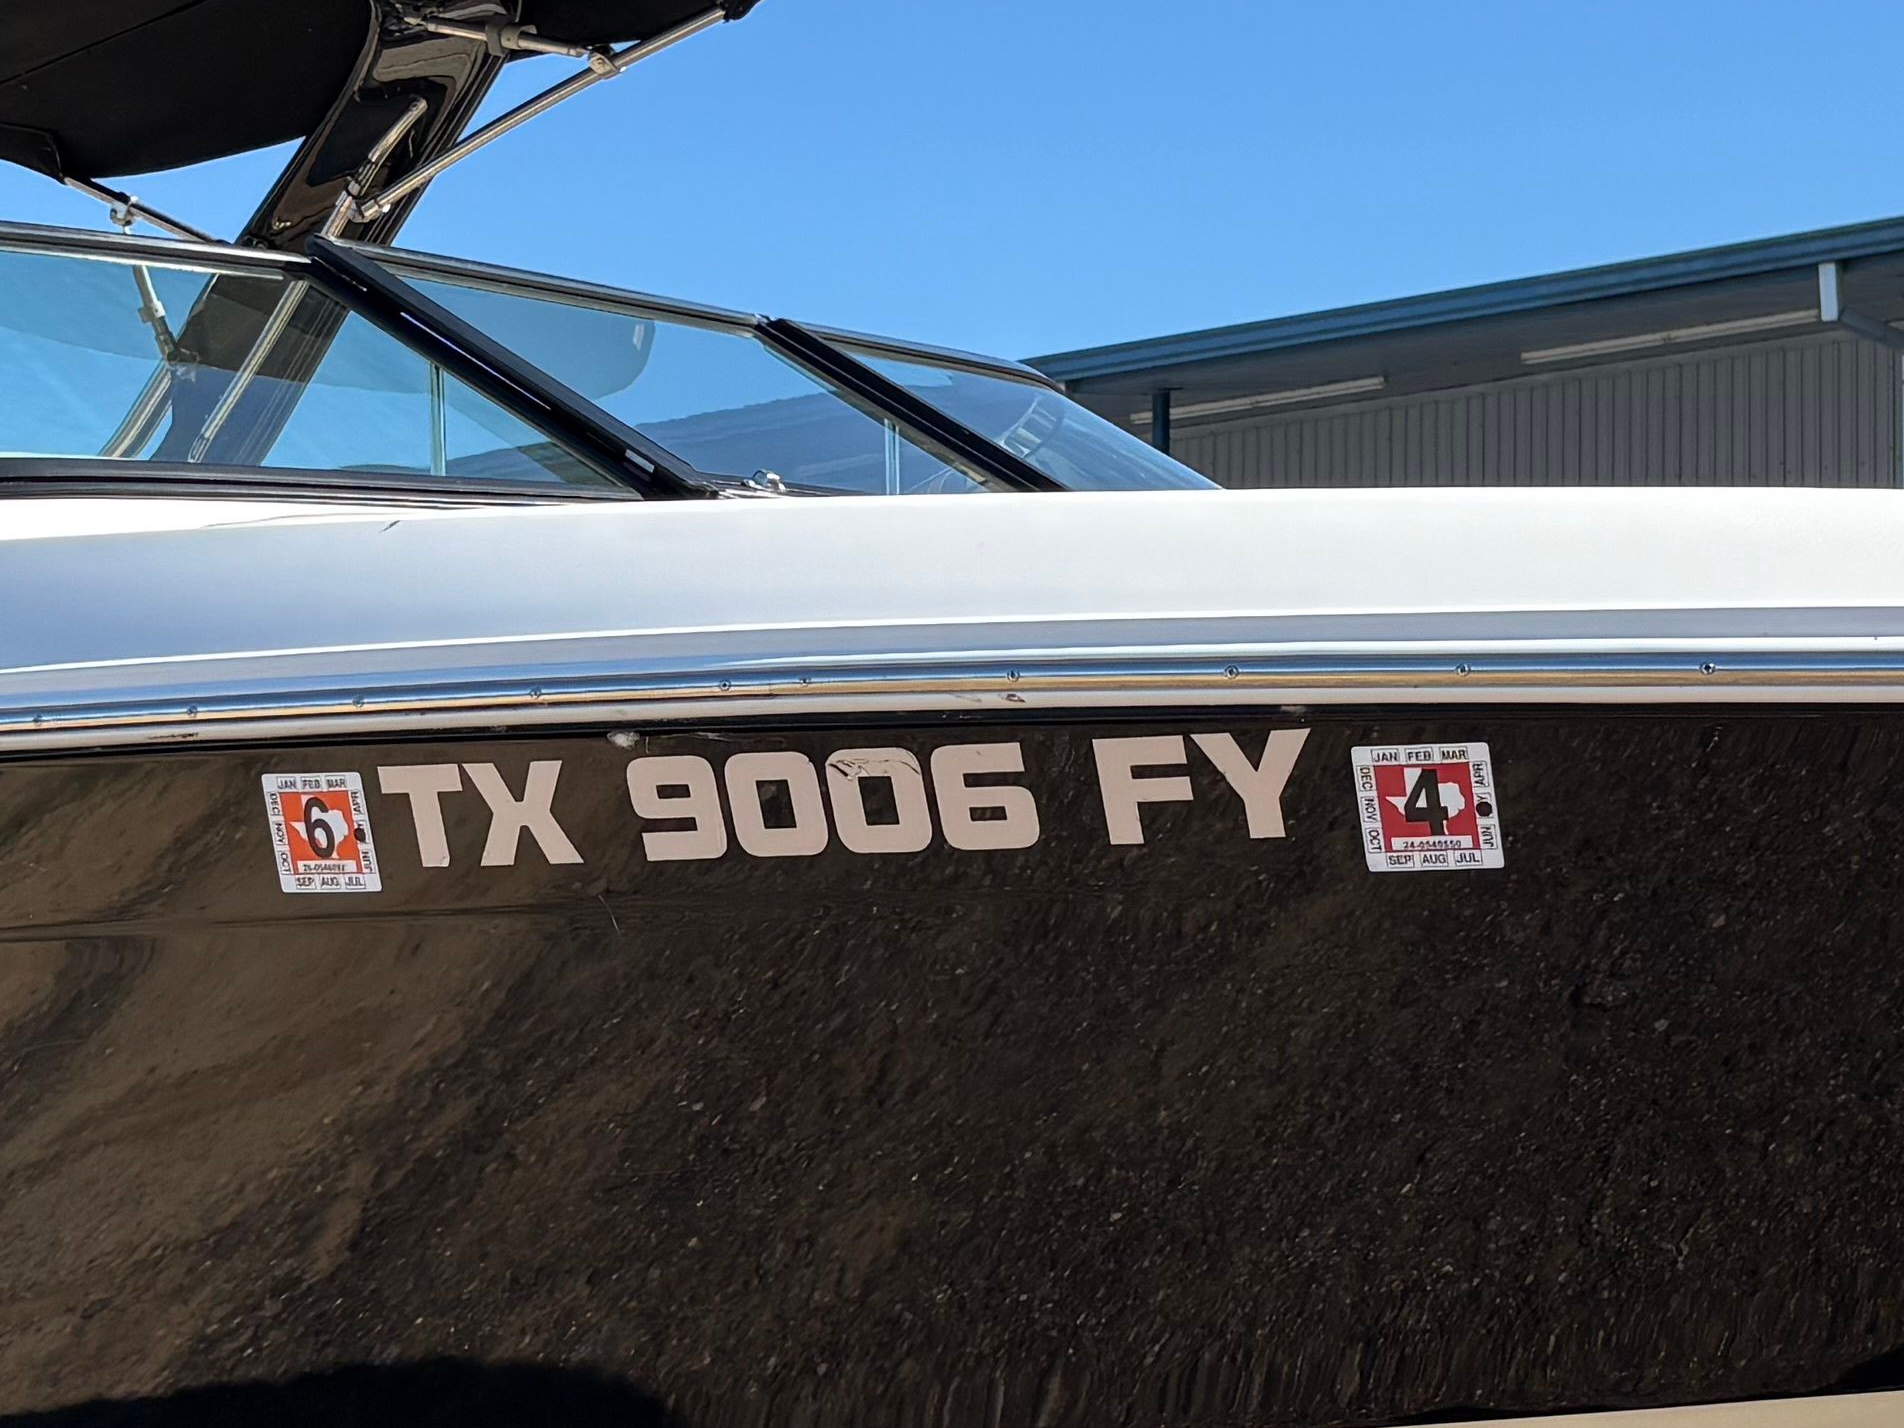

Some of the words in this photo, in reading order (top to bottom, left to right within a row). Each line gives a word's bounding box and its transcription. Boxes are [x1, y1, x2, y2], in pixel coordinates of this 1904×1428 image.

[1374, 751, 1398, 762] JAN
[1407, 750, 1431, 762] FEB
[1441, 749, 1466, 761] MAR
[277, 780, 297, 790] JAN
[1359, 766, 1373, 790] DEC
[1472, 763, 1485, 787] APR
[269, 793, 281, 816] DEC
[377, 760, 584, 867] TX
[626, 742, 1040, 862] 9006
[1092, 727, 1312, 846] FY
[1404, 769, 1449, 836] 4
[1364, 798, 1378, 822] NOV
[304, 796, 335, 859] 6
[1481, 826, 1494, 848] JUN
[1369, 829, 1382, 851] OCT
[280, 852, 291, 873] OCT
[361, 851, 373, 872] JUN
[1388, 855, 1413, 866] SEP
[1422, 853, 1446, 864] AUG
[1456, 852, 1480, 863] JUL
[297, 876, 315, 887] SEP
[320, 876, 340, 887] AUG
